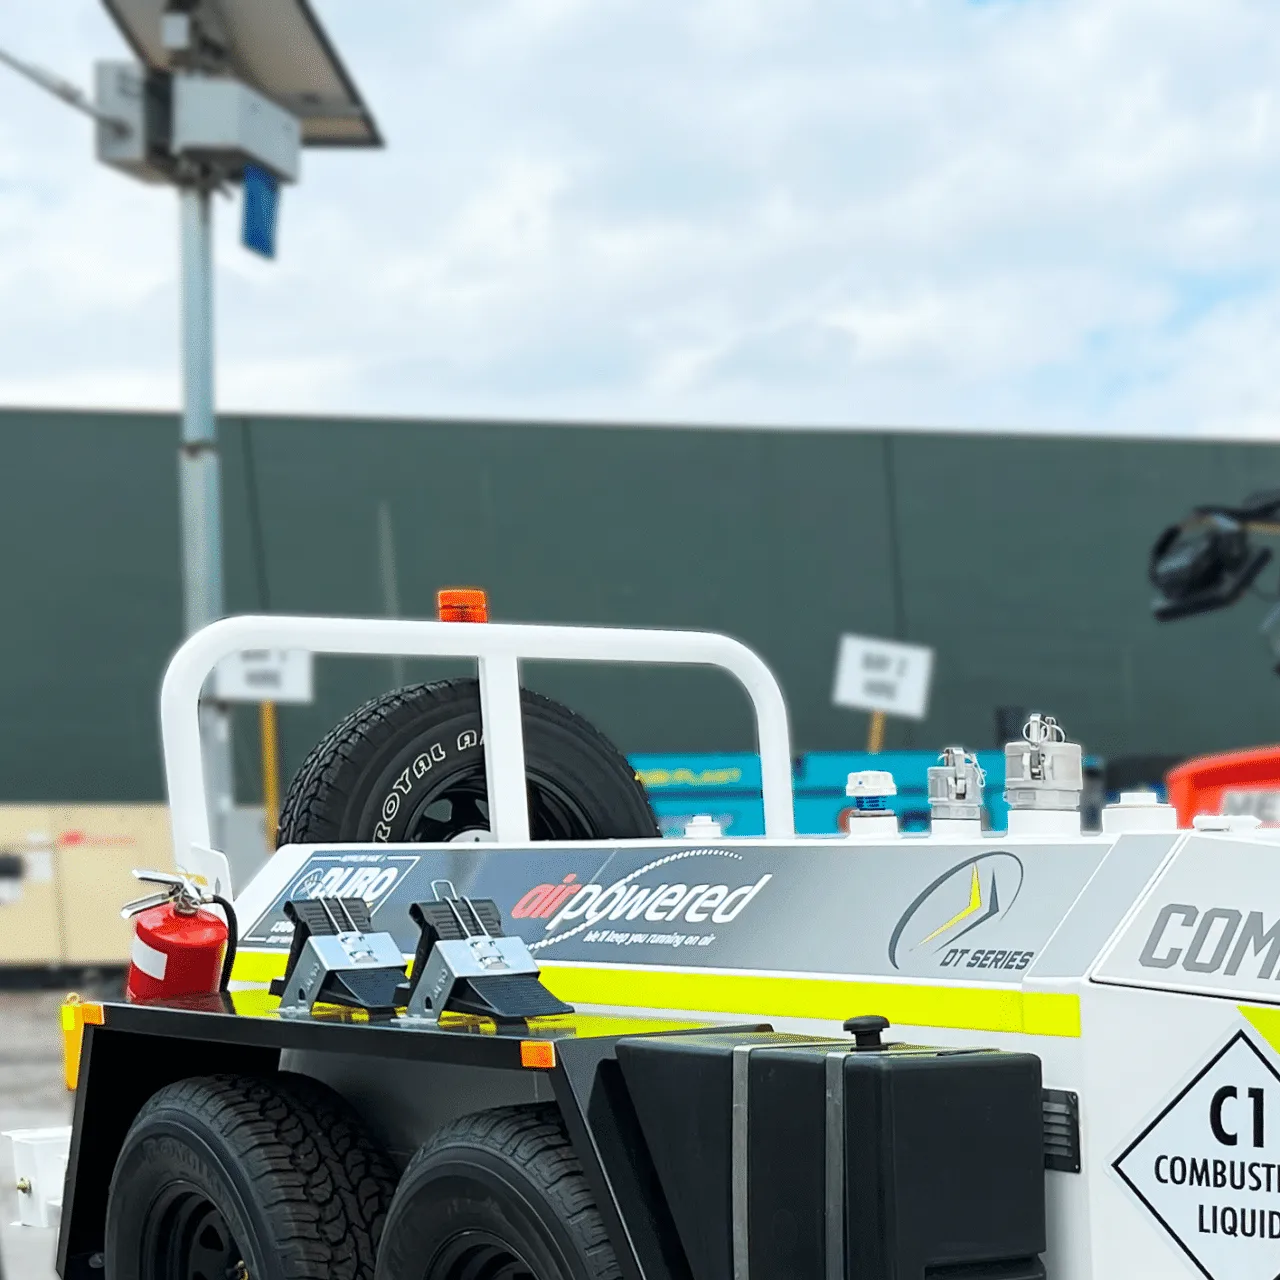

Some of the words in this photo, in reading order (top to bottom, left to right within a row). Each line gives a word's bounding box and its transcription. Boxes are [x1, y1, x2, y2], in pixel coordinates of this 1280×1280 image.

[373, 742, 446, 842] ROYAL
[306, 866, 398, 903] DURO
[511, 873, 773, 930] airpowered
[625, 933, 649, 946] you
[646, 932, 686, 948] running
[684, 935, 700, 945] on
[940, 948, 971, 968] DT
[966, 949, 1035, 970] SERIES
[1209, 1084, 1264, 1148] C1
